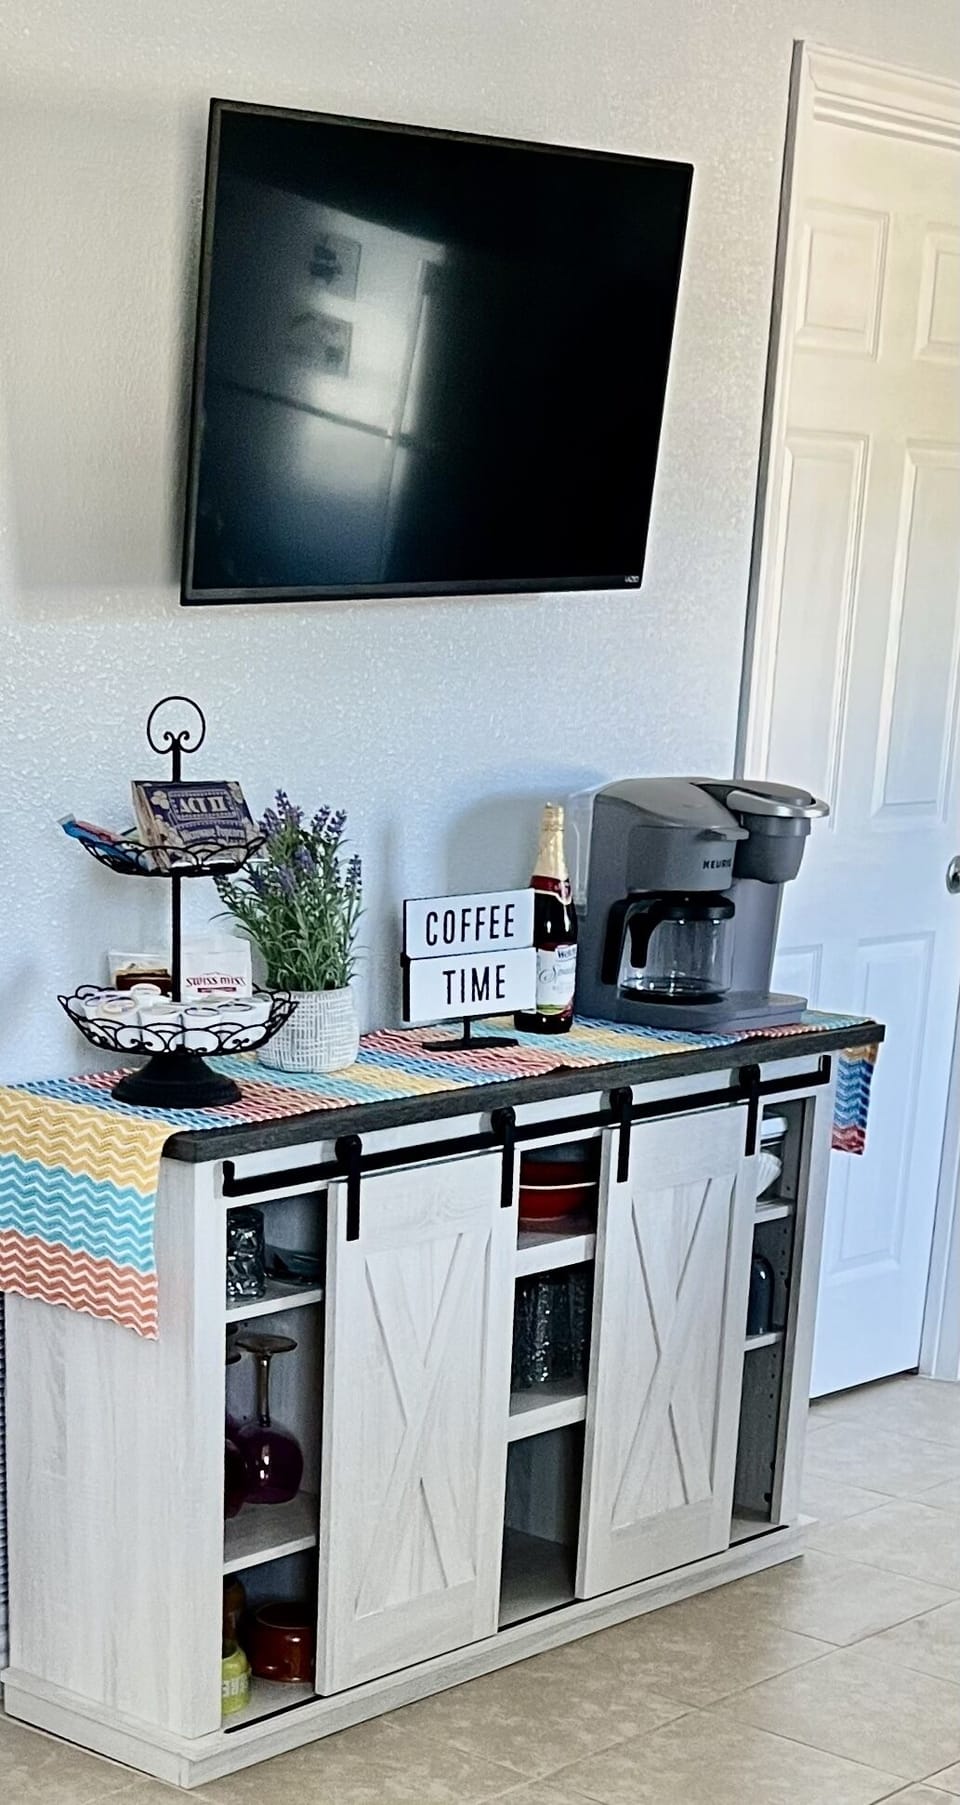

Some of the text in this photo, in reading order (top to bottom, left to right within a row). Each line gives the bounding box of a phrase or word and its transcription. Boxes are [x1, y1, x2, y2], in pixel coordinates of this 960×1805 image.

[179, 796, 228, 814] ACT II
[426, 904, 515, 946] COFFEE
[185, 977, 218, 988] SWISS
[442, 964, 506, 1005] TIME
